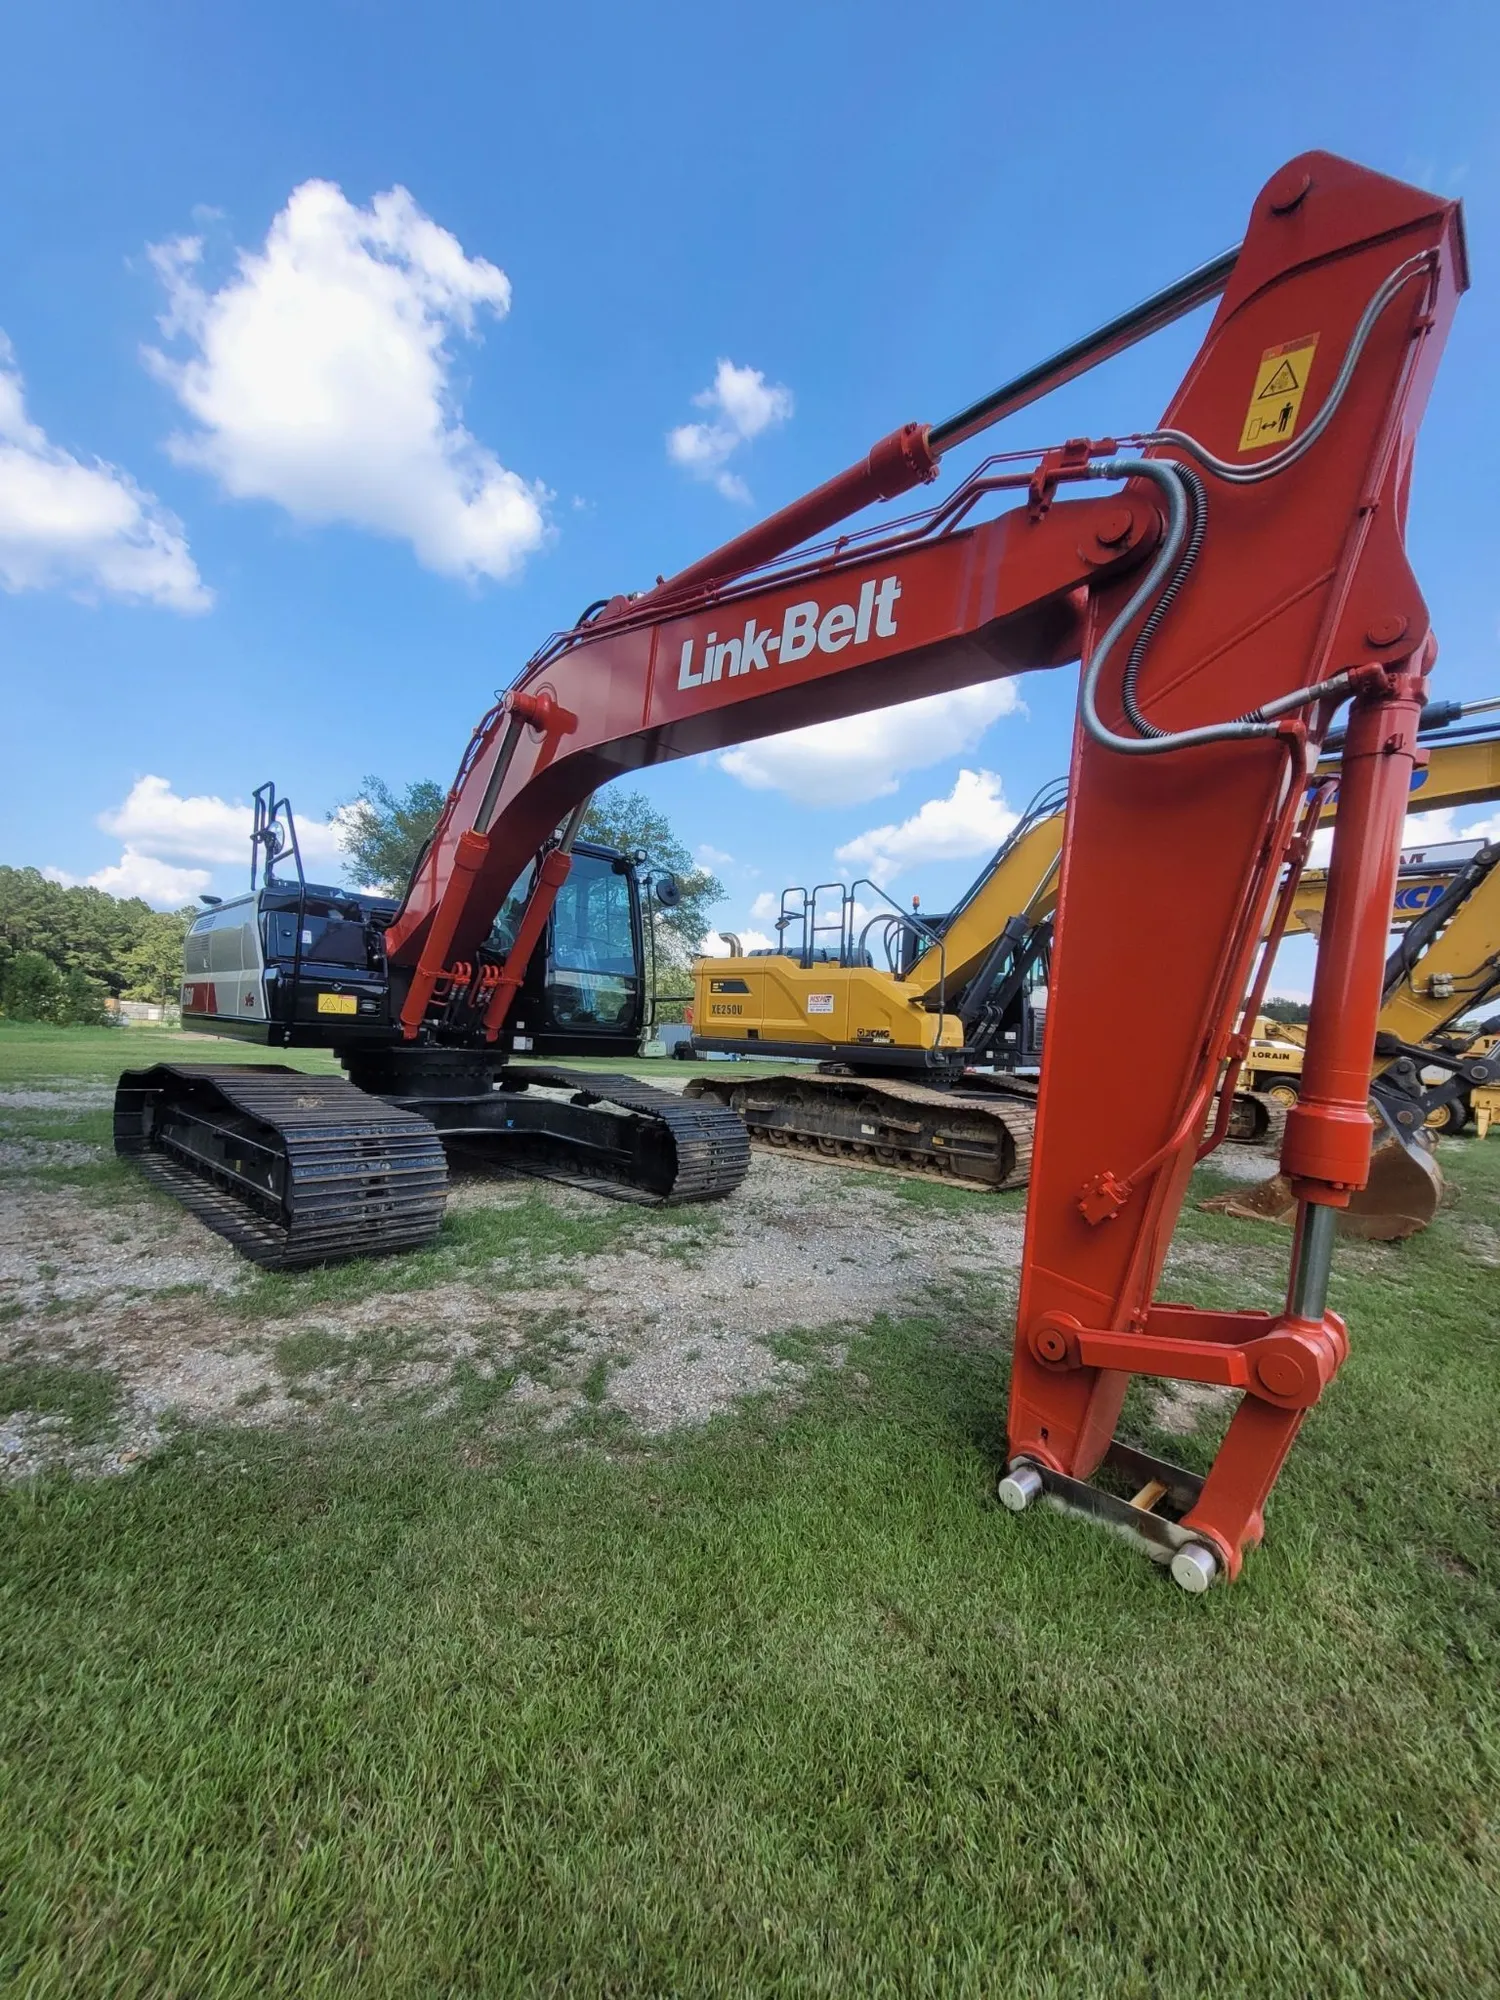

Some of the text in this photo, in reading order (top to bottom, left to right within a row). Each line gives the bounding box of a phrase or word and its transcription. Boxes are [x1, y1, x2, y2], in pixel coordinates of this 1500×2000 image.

[677, 575, 902, 691] Link-Belt
[711, 1004, 743, 1015] XE250U
[1252, 1051, 1290, 1060] LORAIN
